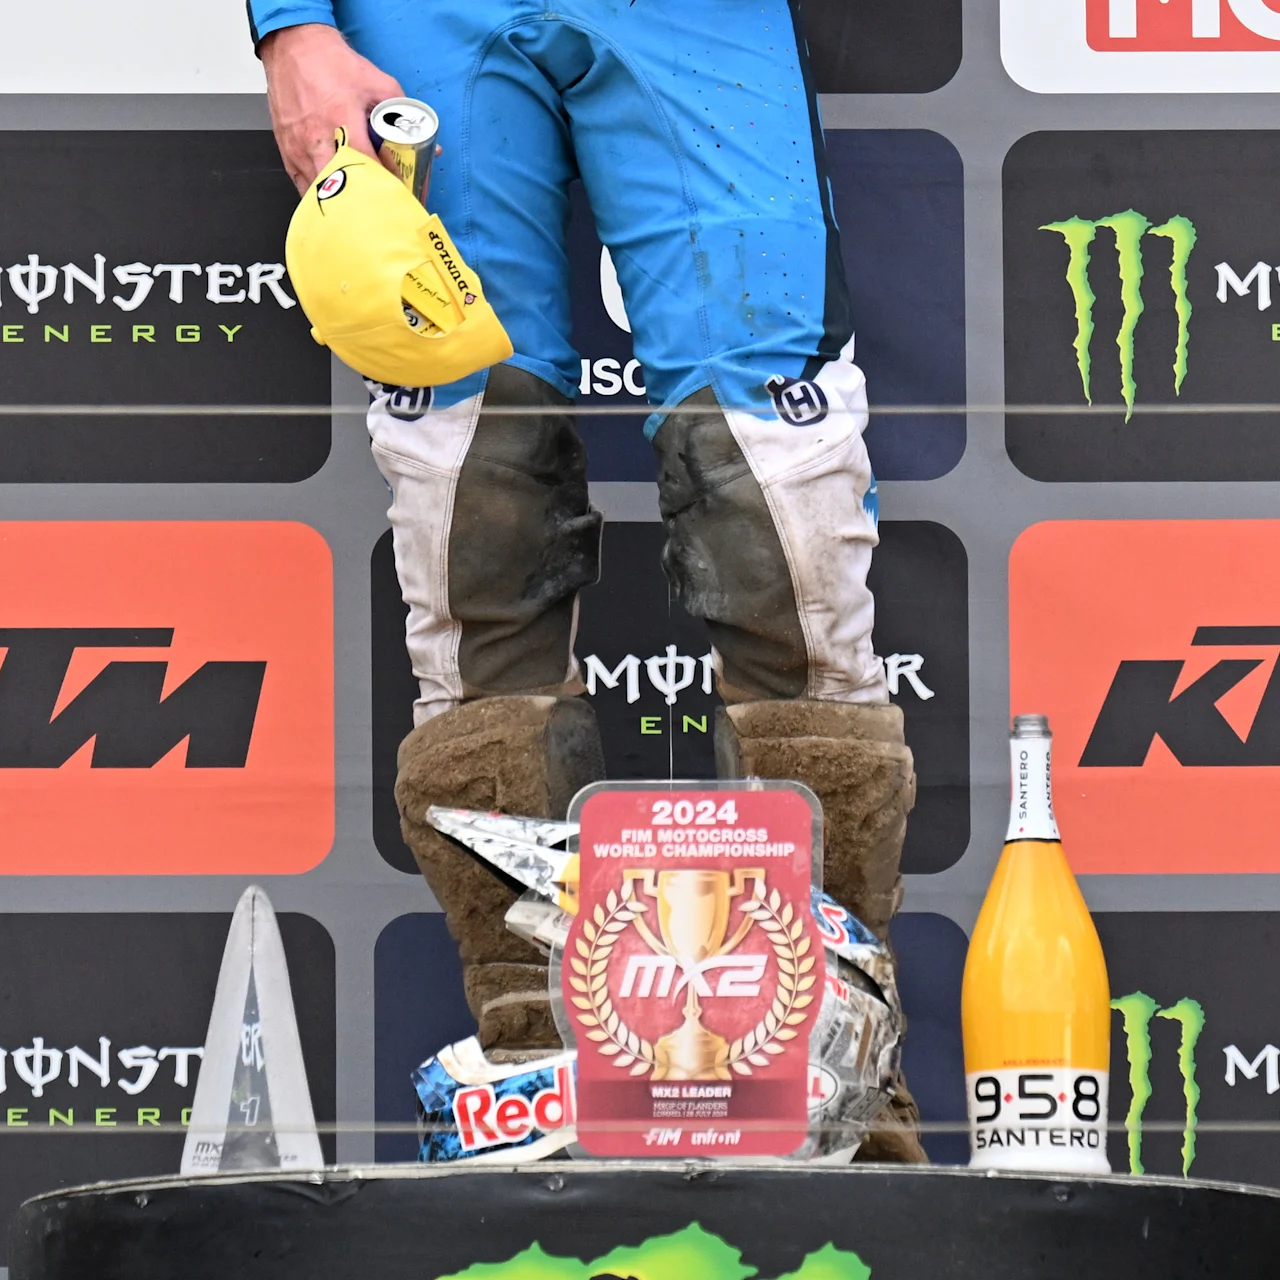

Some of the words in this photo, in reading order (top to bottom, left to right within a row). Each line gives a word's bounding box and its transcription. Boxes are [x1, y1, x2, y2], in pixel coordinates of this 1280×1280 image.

[428, 230, 469, 293] DUNLOP
[3, 324, 243, 343] ENERGY
[1018, 750, 1029, 820] SANTERO
[651, 799, 738, 825] 2024
[621, 829, 652, 843] FIM
[657, 828, 768, 843] MOTOCROSS
[593, 844, 657, 858] WORLD
[662, 843, 795, 858] CHAMPIONSHIP
[618, 954, 768, 1003] MX2
[651, 1087, 680, 1098] MX2
[682, 1087, 732, 1098] LEADER
[456, 1066, 575, 1148] Red
[689, 1102, 728, 1111] FLANDERS
[648, 1128, 682, 1146] FIM
[976, 1127, 1100, 1150] SANTERO
